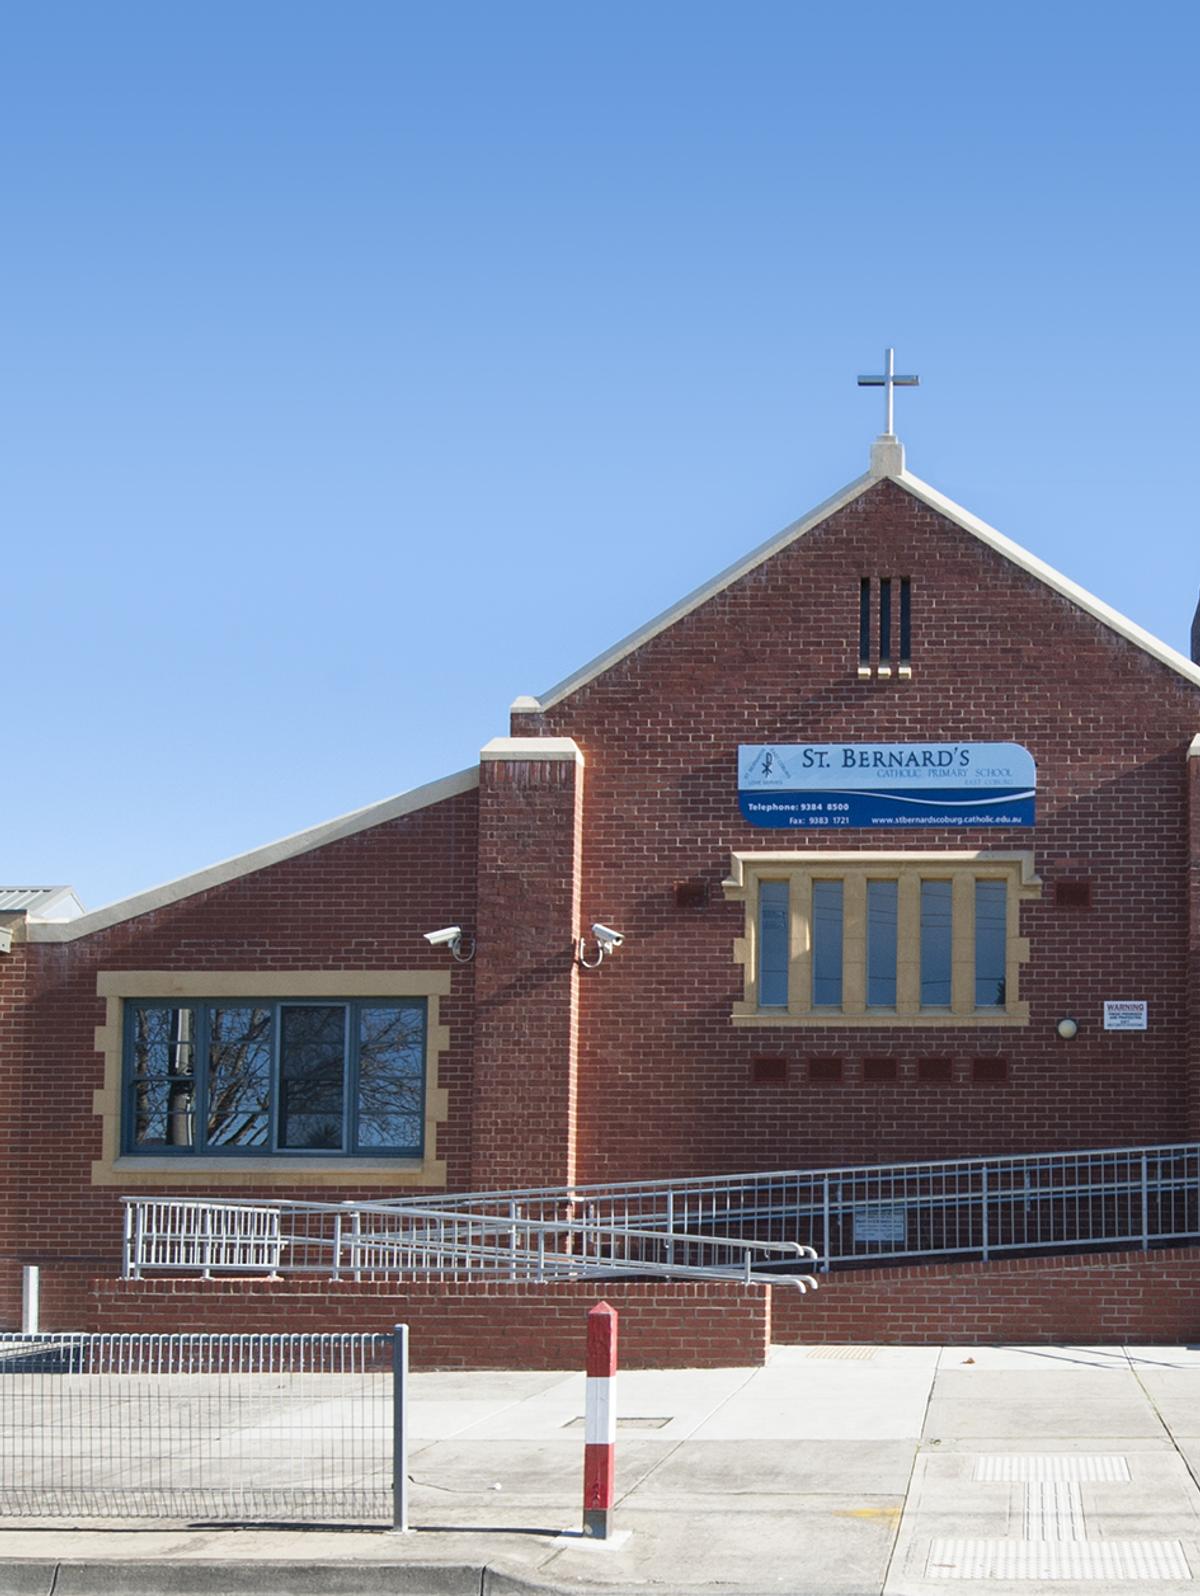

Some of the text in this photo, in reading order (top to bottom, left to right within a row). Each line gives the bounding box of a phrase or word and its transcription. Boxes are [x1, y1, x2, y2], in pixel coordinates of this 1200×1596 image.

[802, 748, 830, 768] ST.
[842, 747, 970, 769] BERNARD'S
[876, 767, 1013, 778] CATHOLIC PRIMARY SCHOOL
[748, 803, 850, 813] Telephone: 9384 8500
[808, 816, 829, 825] 9383
[832, 816, 850, 825] 1721
[1106, 1003, 1144, 1011] WARNING
